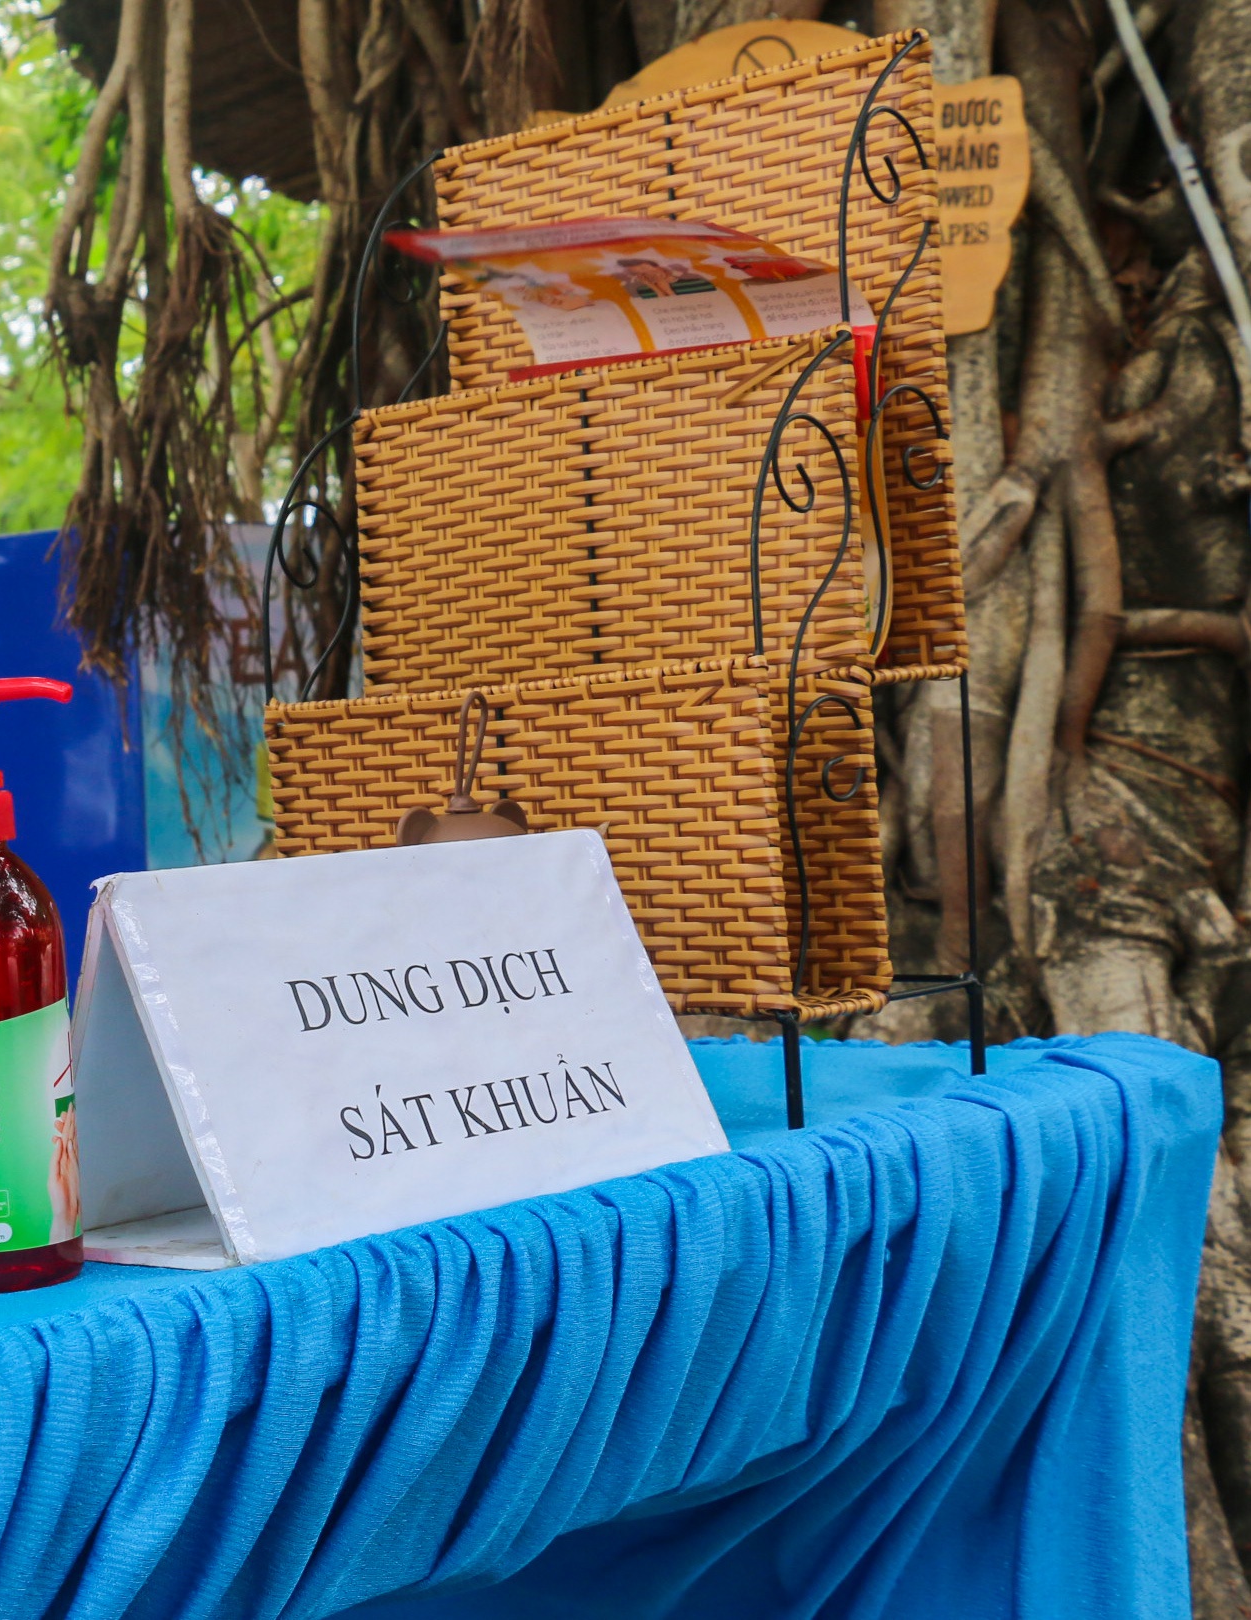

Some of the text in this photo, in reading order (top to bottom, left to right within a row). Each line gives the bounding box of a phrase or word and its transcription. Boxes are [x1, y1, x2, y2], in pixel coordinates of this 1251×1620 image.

[942, 97, 1003, 134] ĐƯỢC
[284, 948, 573, 1032] DUNG DỊCH
[339, 1053, 627, 1162] SÁT KHUẨN
